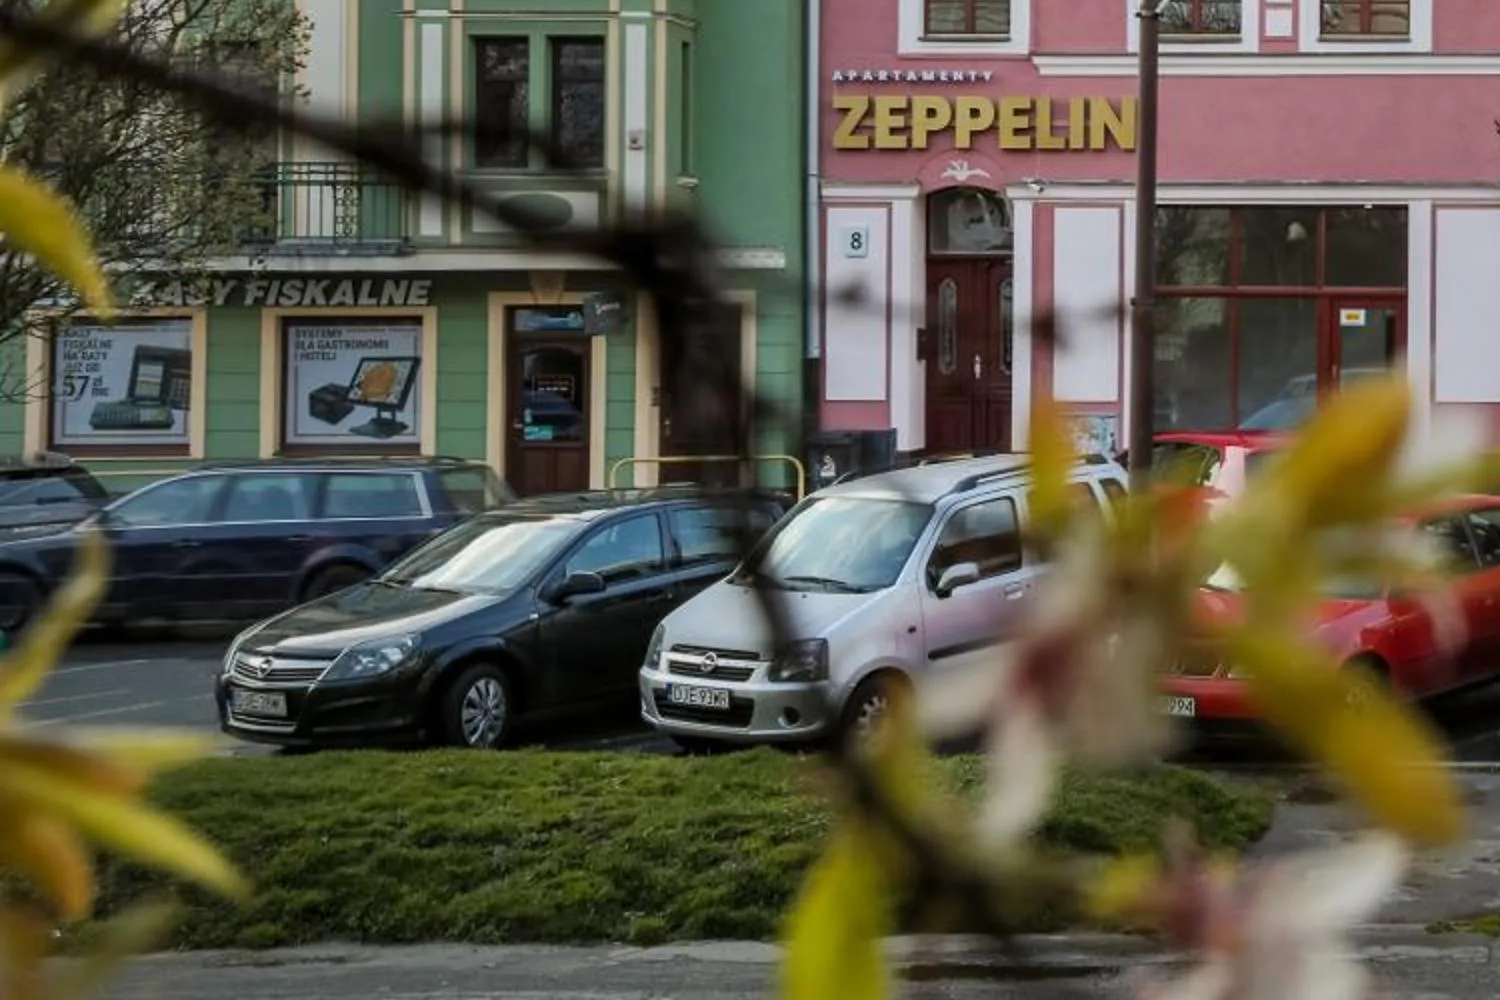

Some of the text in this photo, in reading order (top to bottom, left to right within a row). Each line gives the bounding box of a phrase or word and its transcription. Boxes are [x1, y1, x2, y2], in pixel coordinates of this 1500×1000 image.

[832, 70, 993, 81] APARTAMENTY
[832, 95, 1137, 149] ZEPPELIN
[850, 232, 862, 250] 8
[244, 279, 432, 306] FISKALNE
